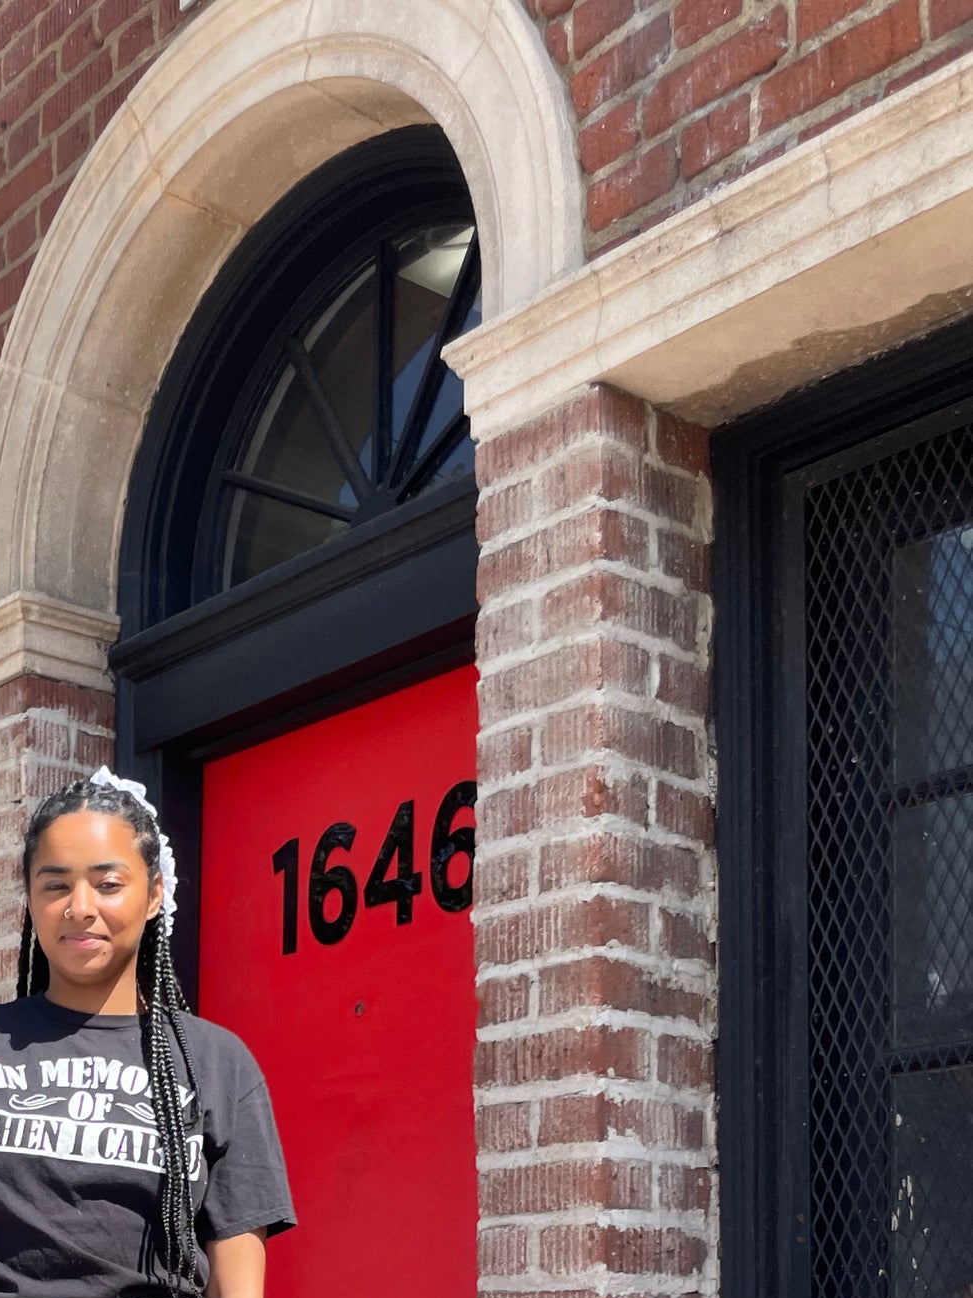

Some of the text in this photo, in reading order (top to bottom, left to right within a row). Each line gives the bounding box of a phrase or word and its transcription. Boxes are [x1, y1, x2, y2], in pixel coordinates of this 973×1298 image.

[272, 780, 477, 955] 1646
[38, 1057, 195, 1109] MEMOY
[68, 1090, 114, 1122] OF
[70, 1124, 88, 1156] I
[97, 1126, 200, 1176] CARD
